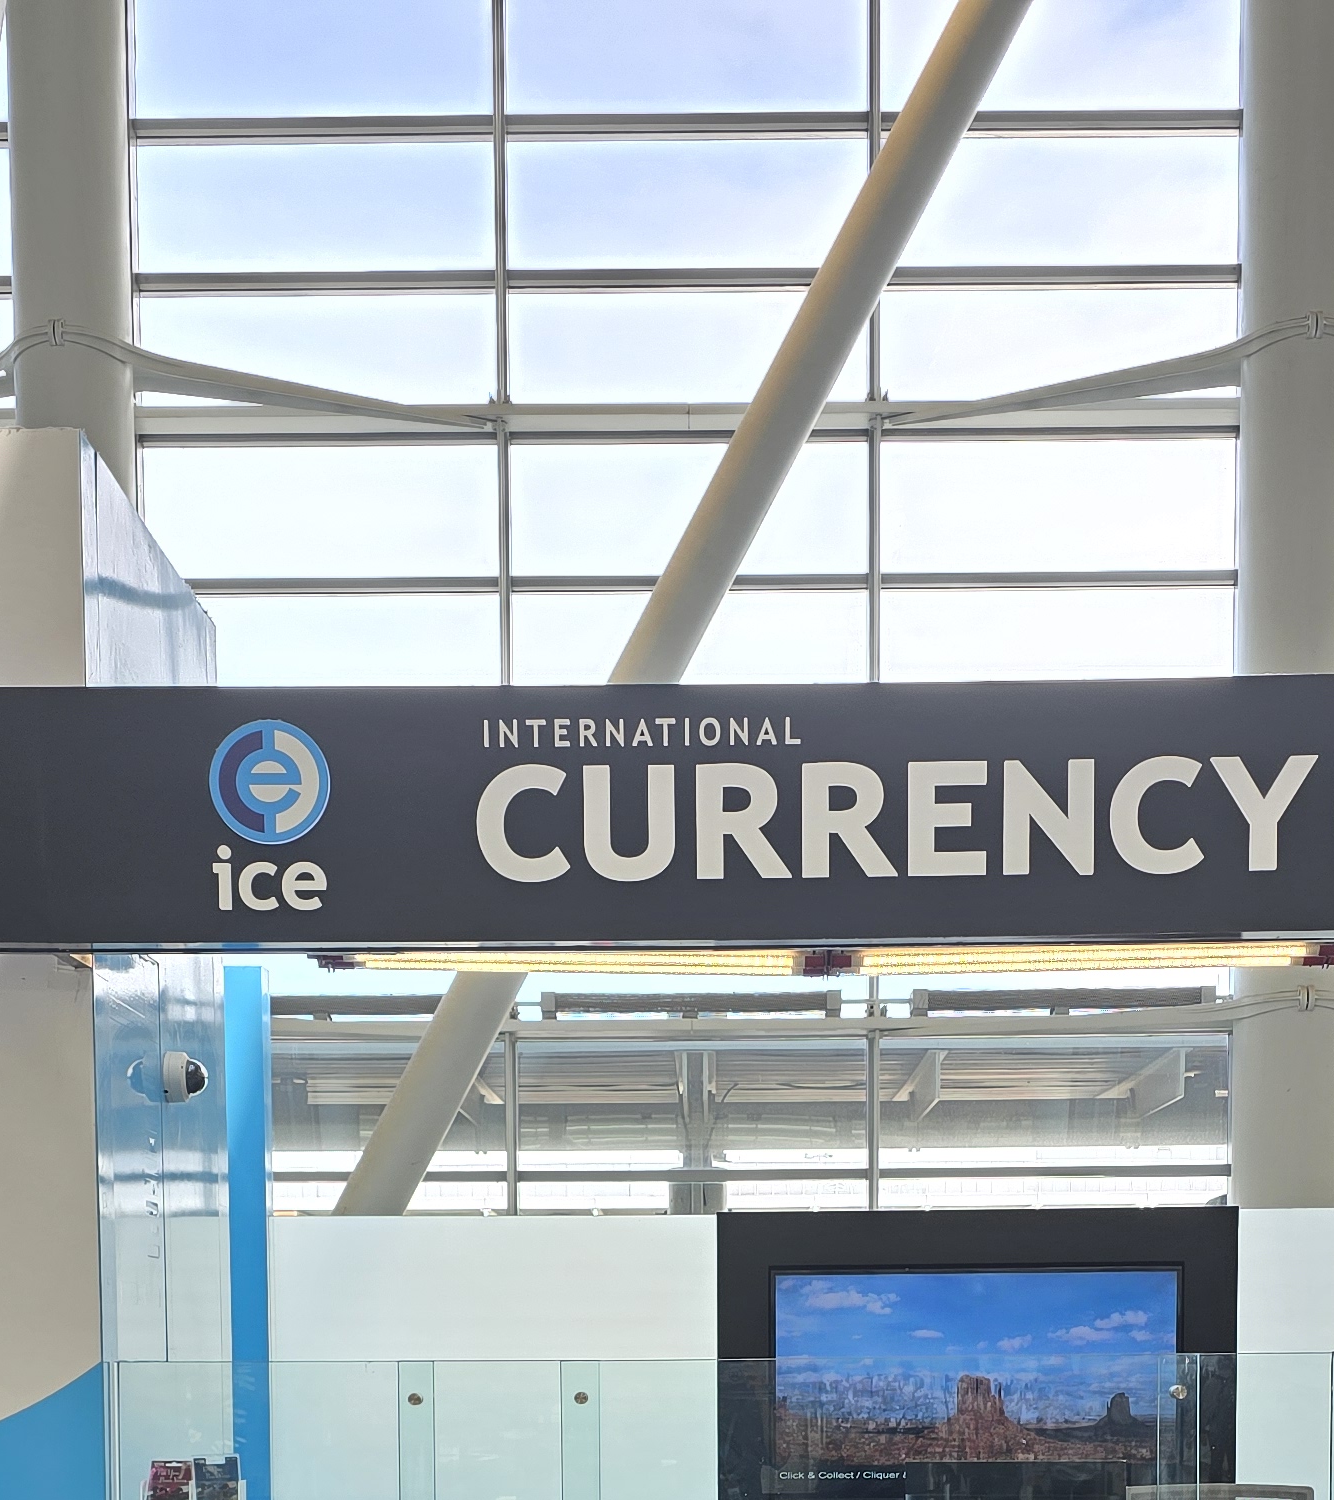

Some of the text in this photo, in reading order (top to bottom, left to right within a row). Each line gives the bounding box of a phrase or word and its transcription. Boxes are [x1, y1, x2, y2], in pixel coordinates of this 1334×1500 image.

[481, 716, 803, 749] INTERNATIONAL
[475, 754, 1319, 883] CURRENCY
[212, 844, 328, 911] ice
[779, 1471, 805, 1480] Click
[807, 1471, 816, 1480] &
[818, 1471, 854, 1480] Collect
[862, 1471, 900, 1481] Cliquer
